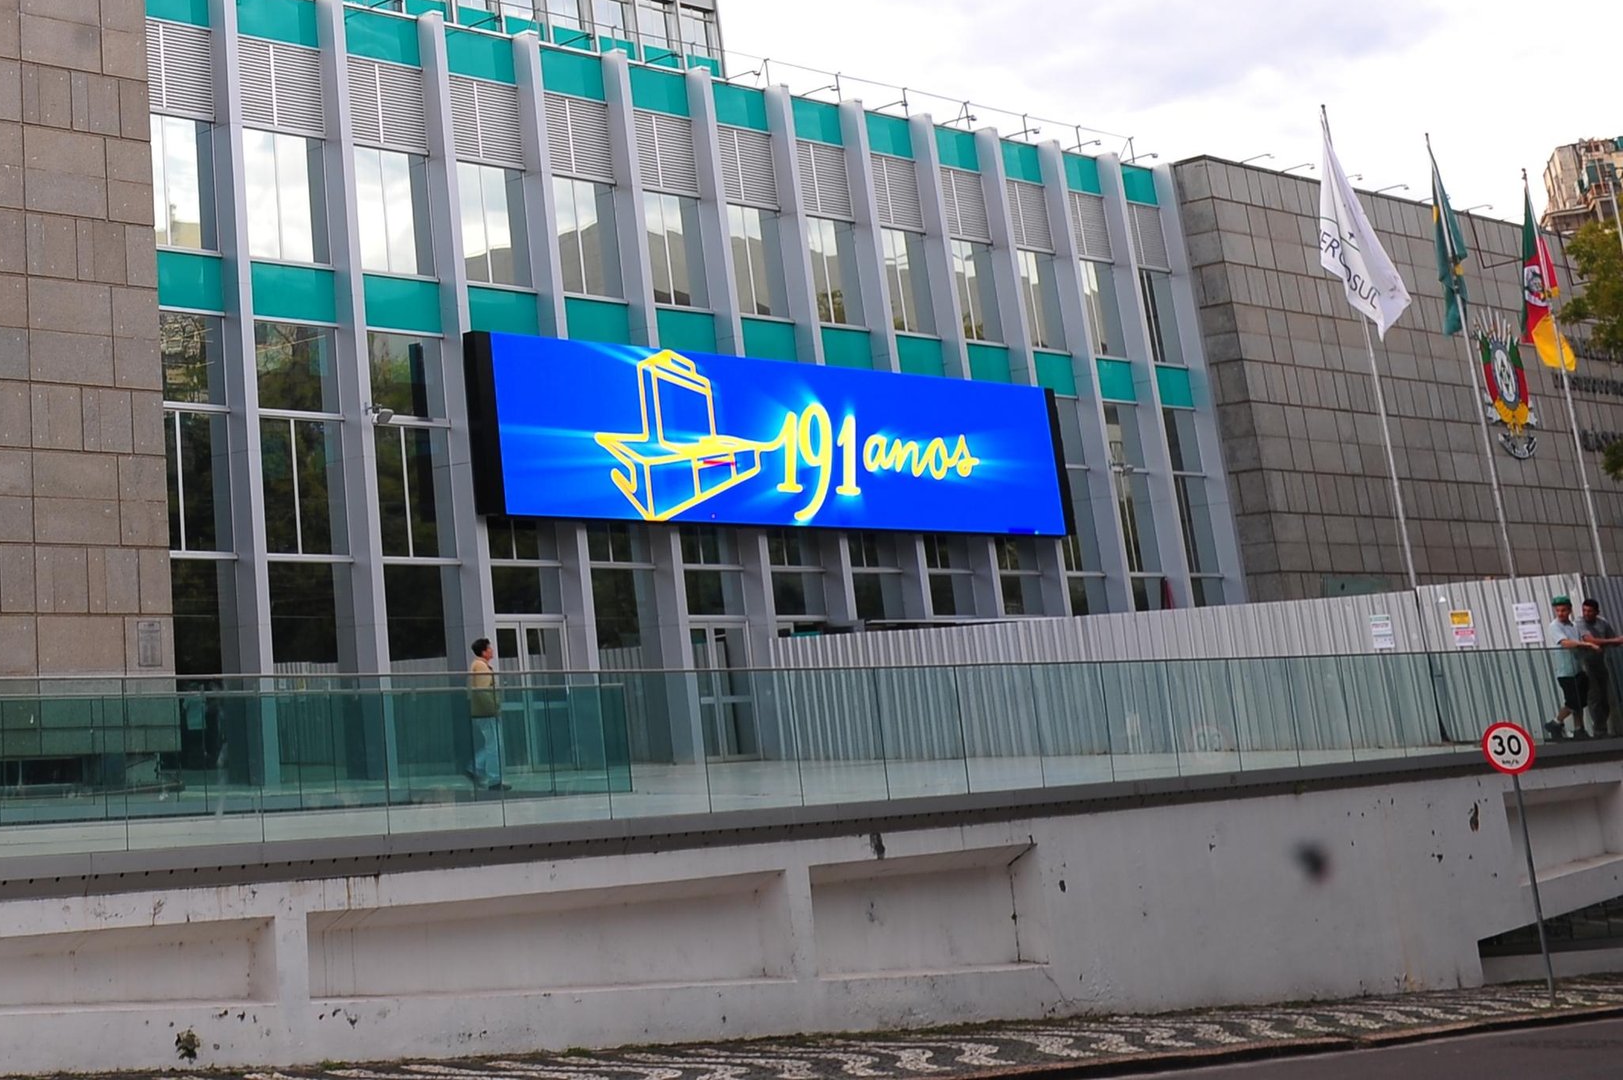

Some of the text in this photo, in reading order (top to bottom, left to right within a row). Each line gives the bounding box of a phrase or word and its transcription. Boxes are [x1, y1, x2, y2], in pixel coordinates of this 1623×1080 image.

[776, 402, 980, 521] 191 anos
[1491, 734, 1522, 756] 30
